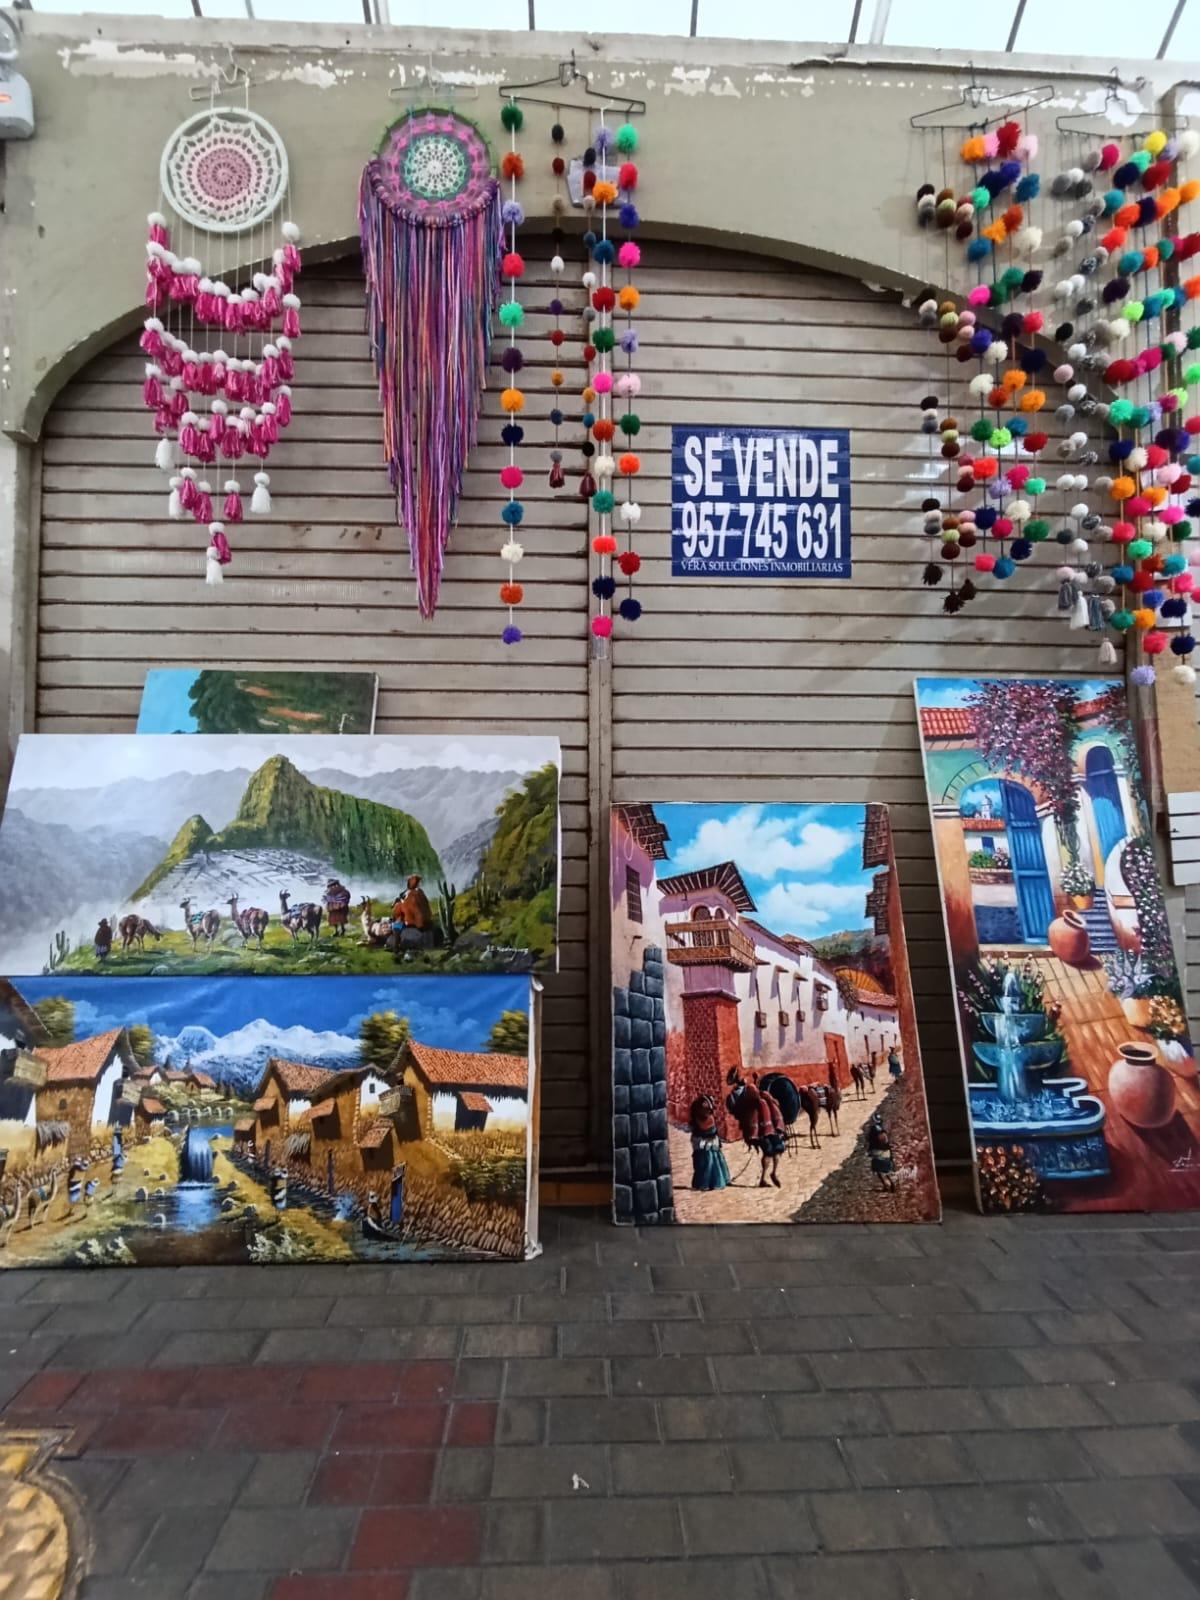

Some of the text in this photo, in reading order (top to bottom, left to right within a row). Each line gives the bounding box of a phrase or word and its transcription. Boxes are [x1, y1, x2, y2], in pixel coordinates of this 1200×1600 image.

[684, 436, 839, 498] SE VENDE
[682, 501, 842, 558] 957 745 631
[681, 561, 843, 572] VERA SOLUCIONES INMOBILIARIAS
